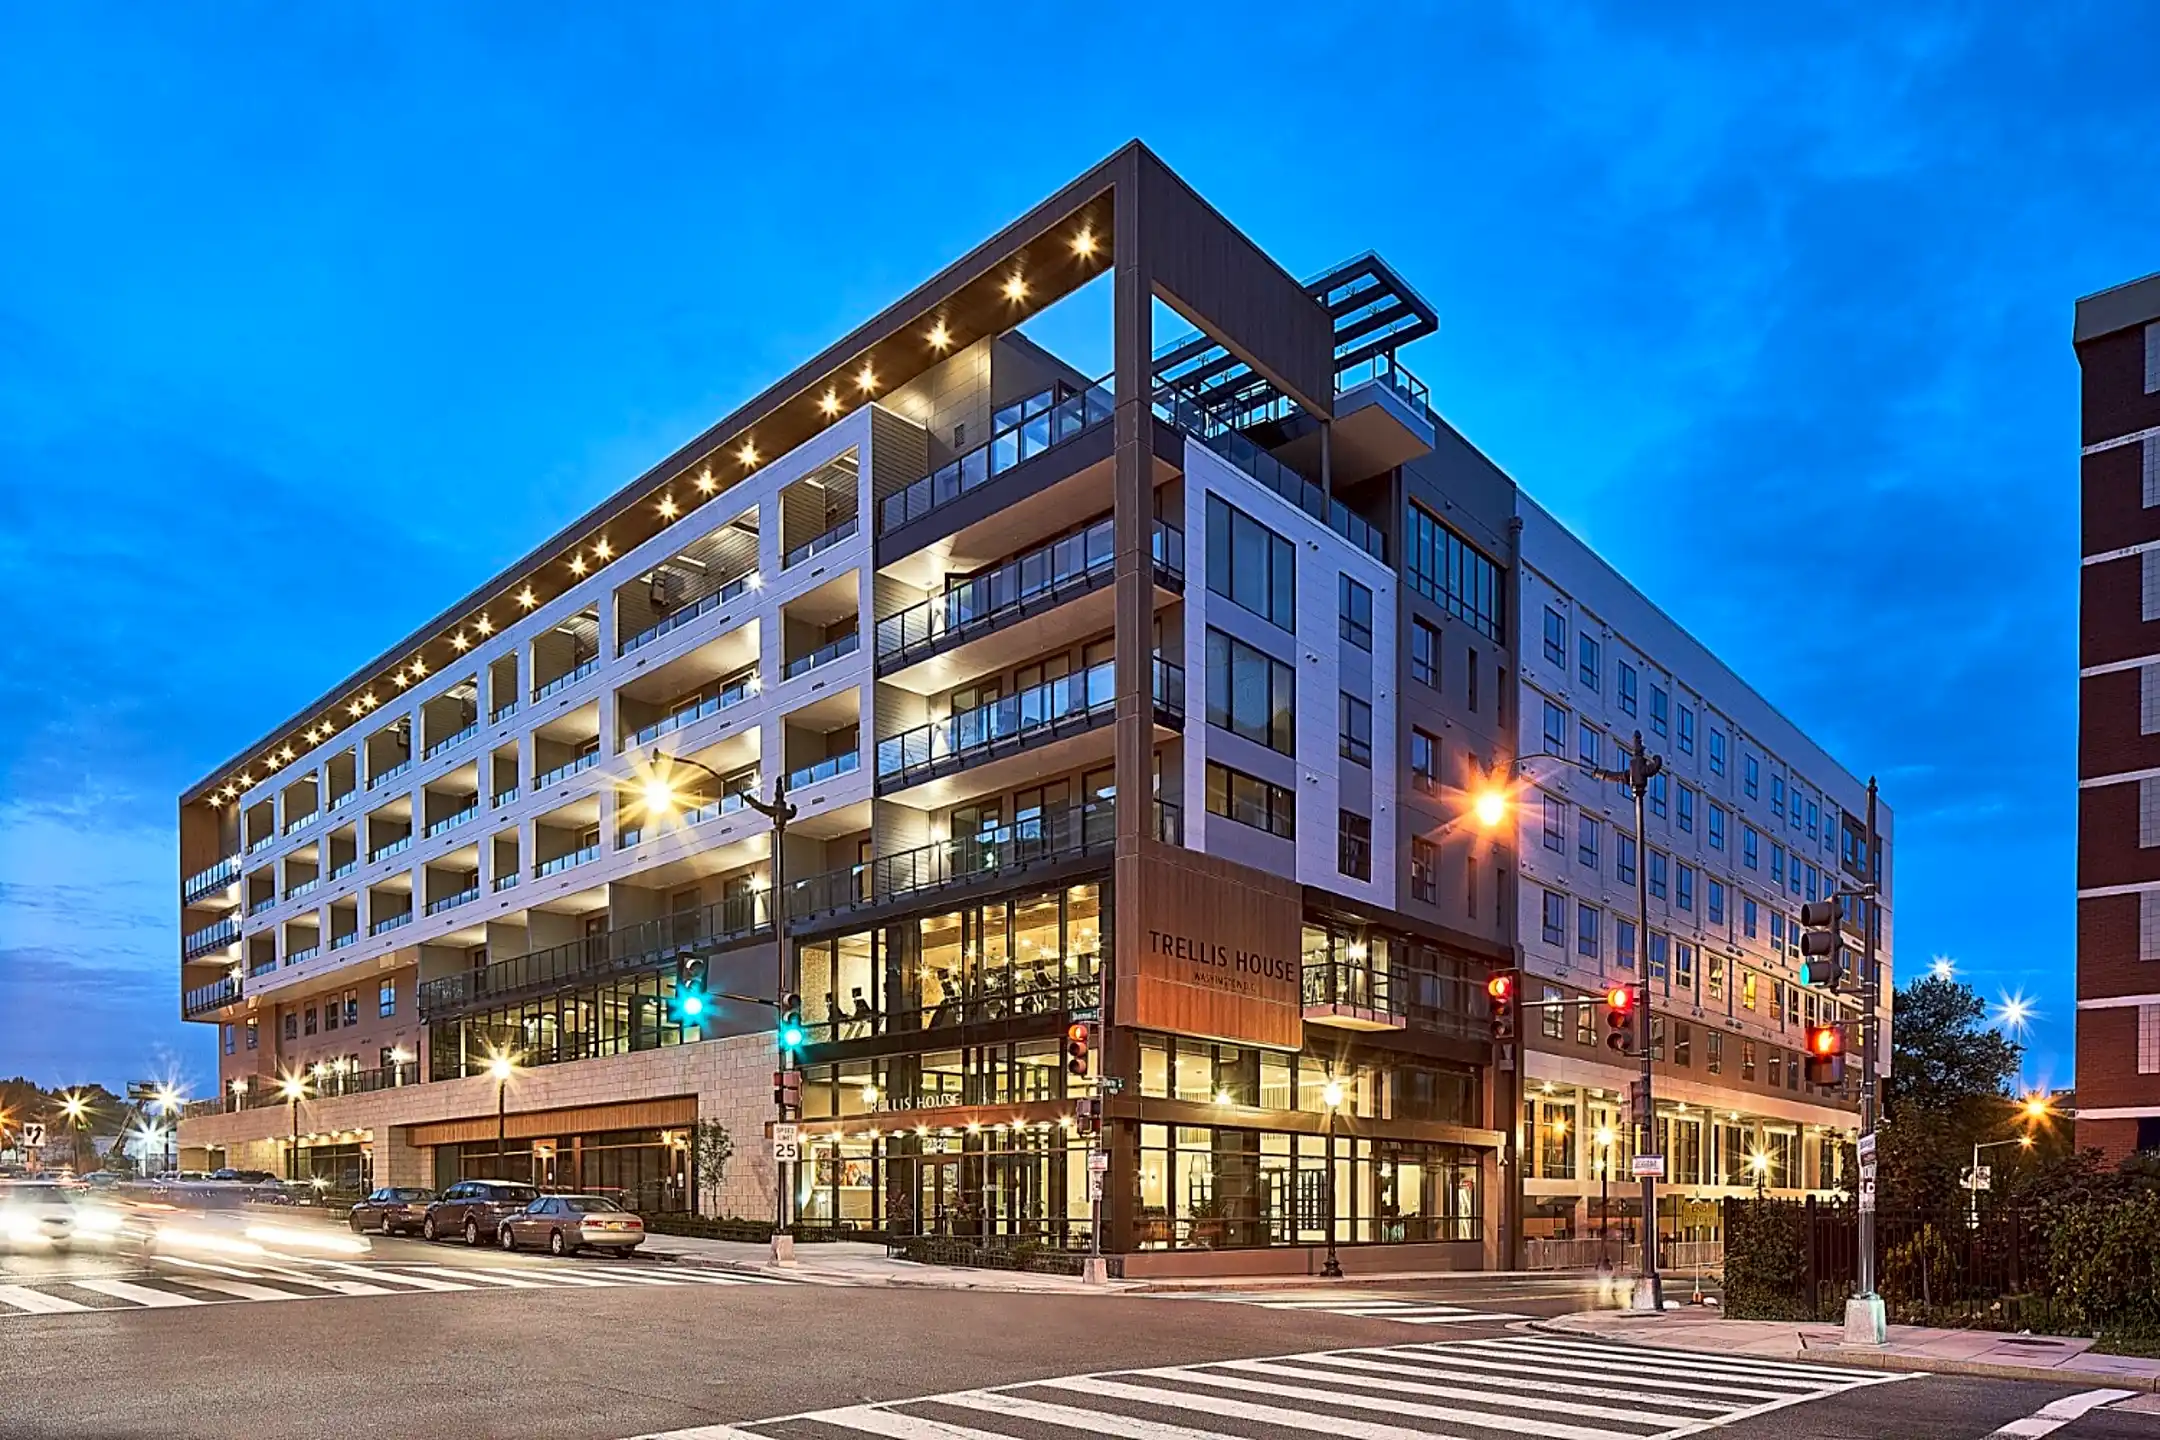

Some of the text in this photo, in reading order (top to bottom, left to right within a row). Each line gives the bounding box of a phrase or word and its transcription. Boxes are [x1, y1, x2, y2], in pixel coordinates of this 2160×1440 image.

[1148, 930, 1295, 982] TRELLIS HOUSE
[865, 1093, 961, 1114] RELLIS HOUSE
[775, 1143, 796, 1157] 25
